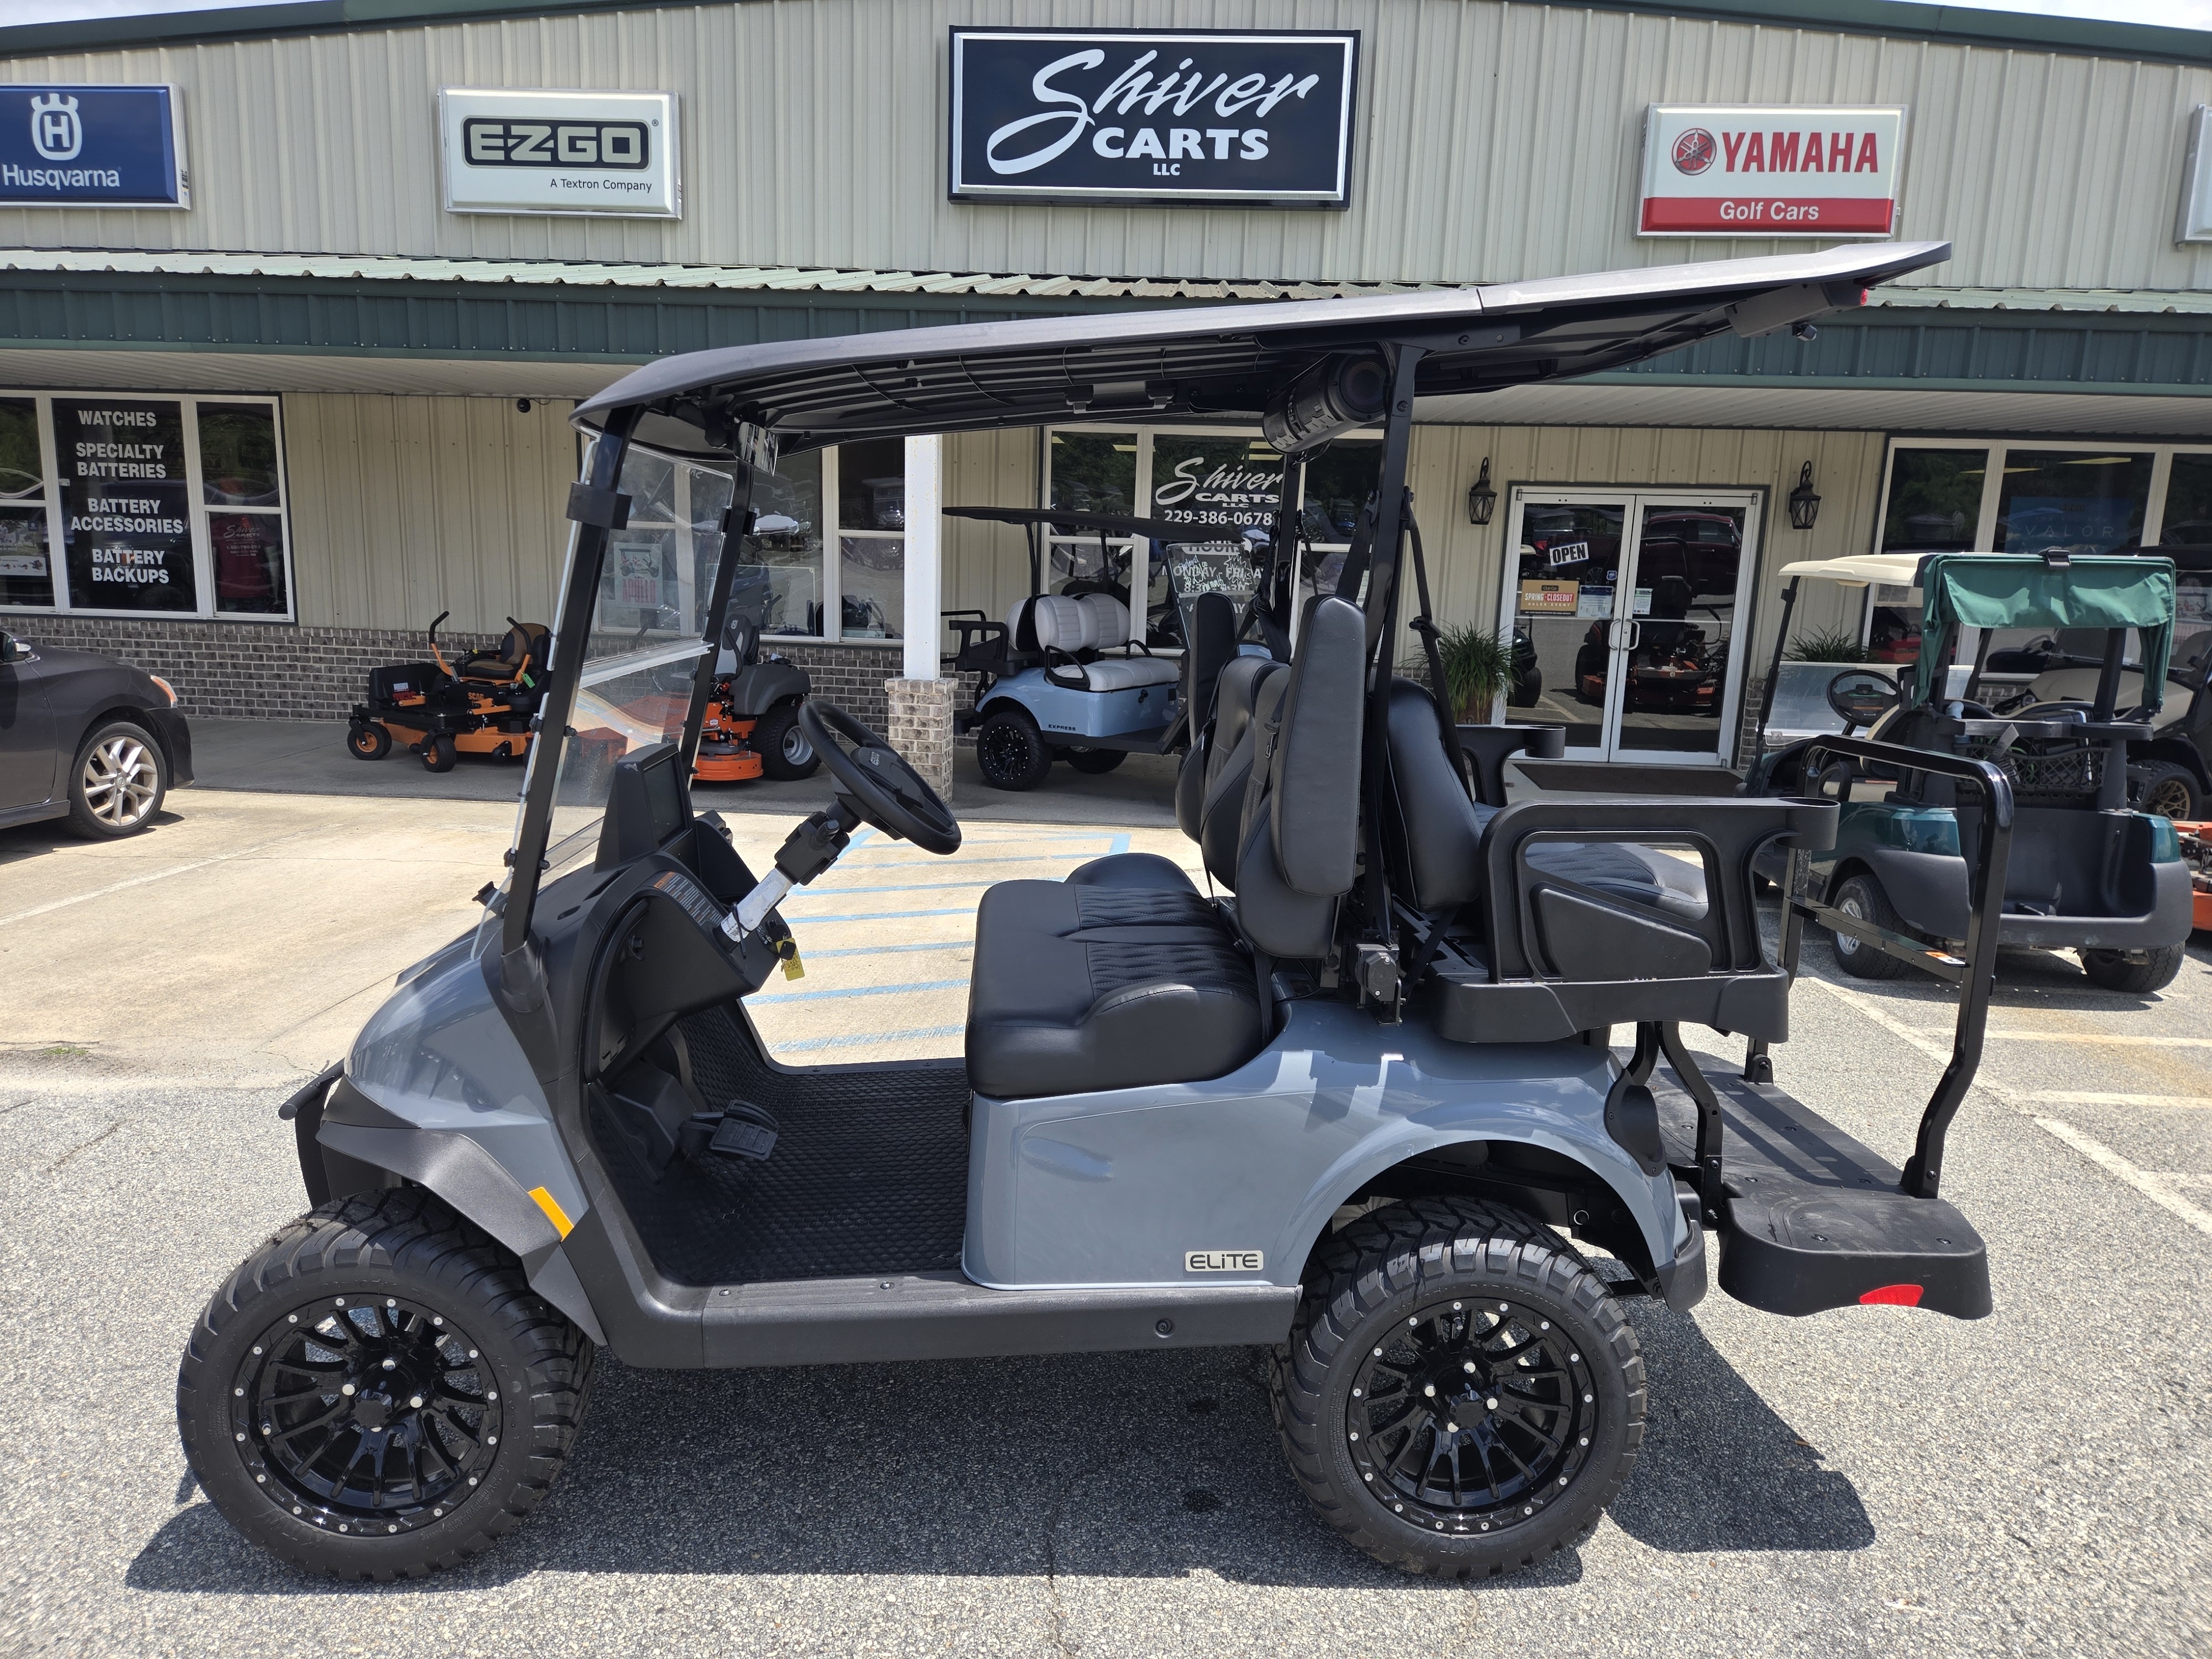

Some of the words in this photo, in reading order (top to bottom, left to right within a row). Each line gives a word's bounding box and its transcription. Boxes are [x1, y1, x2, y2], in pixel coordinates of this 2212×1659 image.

[987, 49, 1319, 175] Shiver
[469, 124, 642, 164] EZGO
[1092, 127, 1269, 160] CARTS
[1721, 132, 1878, 173] YAMAHA
[2, 164, 121, 190] Husqvarna
[1153, 164, 1180, 176] LLC
[550, 179, 557, 189] A
[560, 178, 599, 190] Textron
[603, 180, 652, 192] Company
[1720, 201, 1764, 220] Golf
[1770, 201, 1819, 220] Cars
[78, 410, 156, 427] WATCHES
[76, 443, 164, 460] SPECIALTY
[77, 462, 166, 478] BATTERIES
[1156, 457, 1284, 505] Shiver
[88, 498, 160, 514] BATTERY
[1195, 493, 1280, 503] CARTS
[71, 517, 184, 534] ACCESSORIES
[1164, 509, 1272, 525] 229-386-0678
[2025, 525, 2114, 537] VALOR
[92, 549, 165, 565] BATTERY
[1552, 544, 1586, 564] OPEN
[92, 568, 169, 583] BACKUPS
[622, 579, 656, 603] APOLLO
[1525, 593, 1544, 601] SPRING
[468, 692, 484, 701] SCAG
